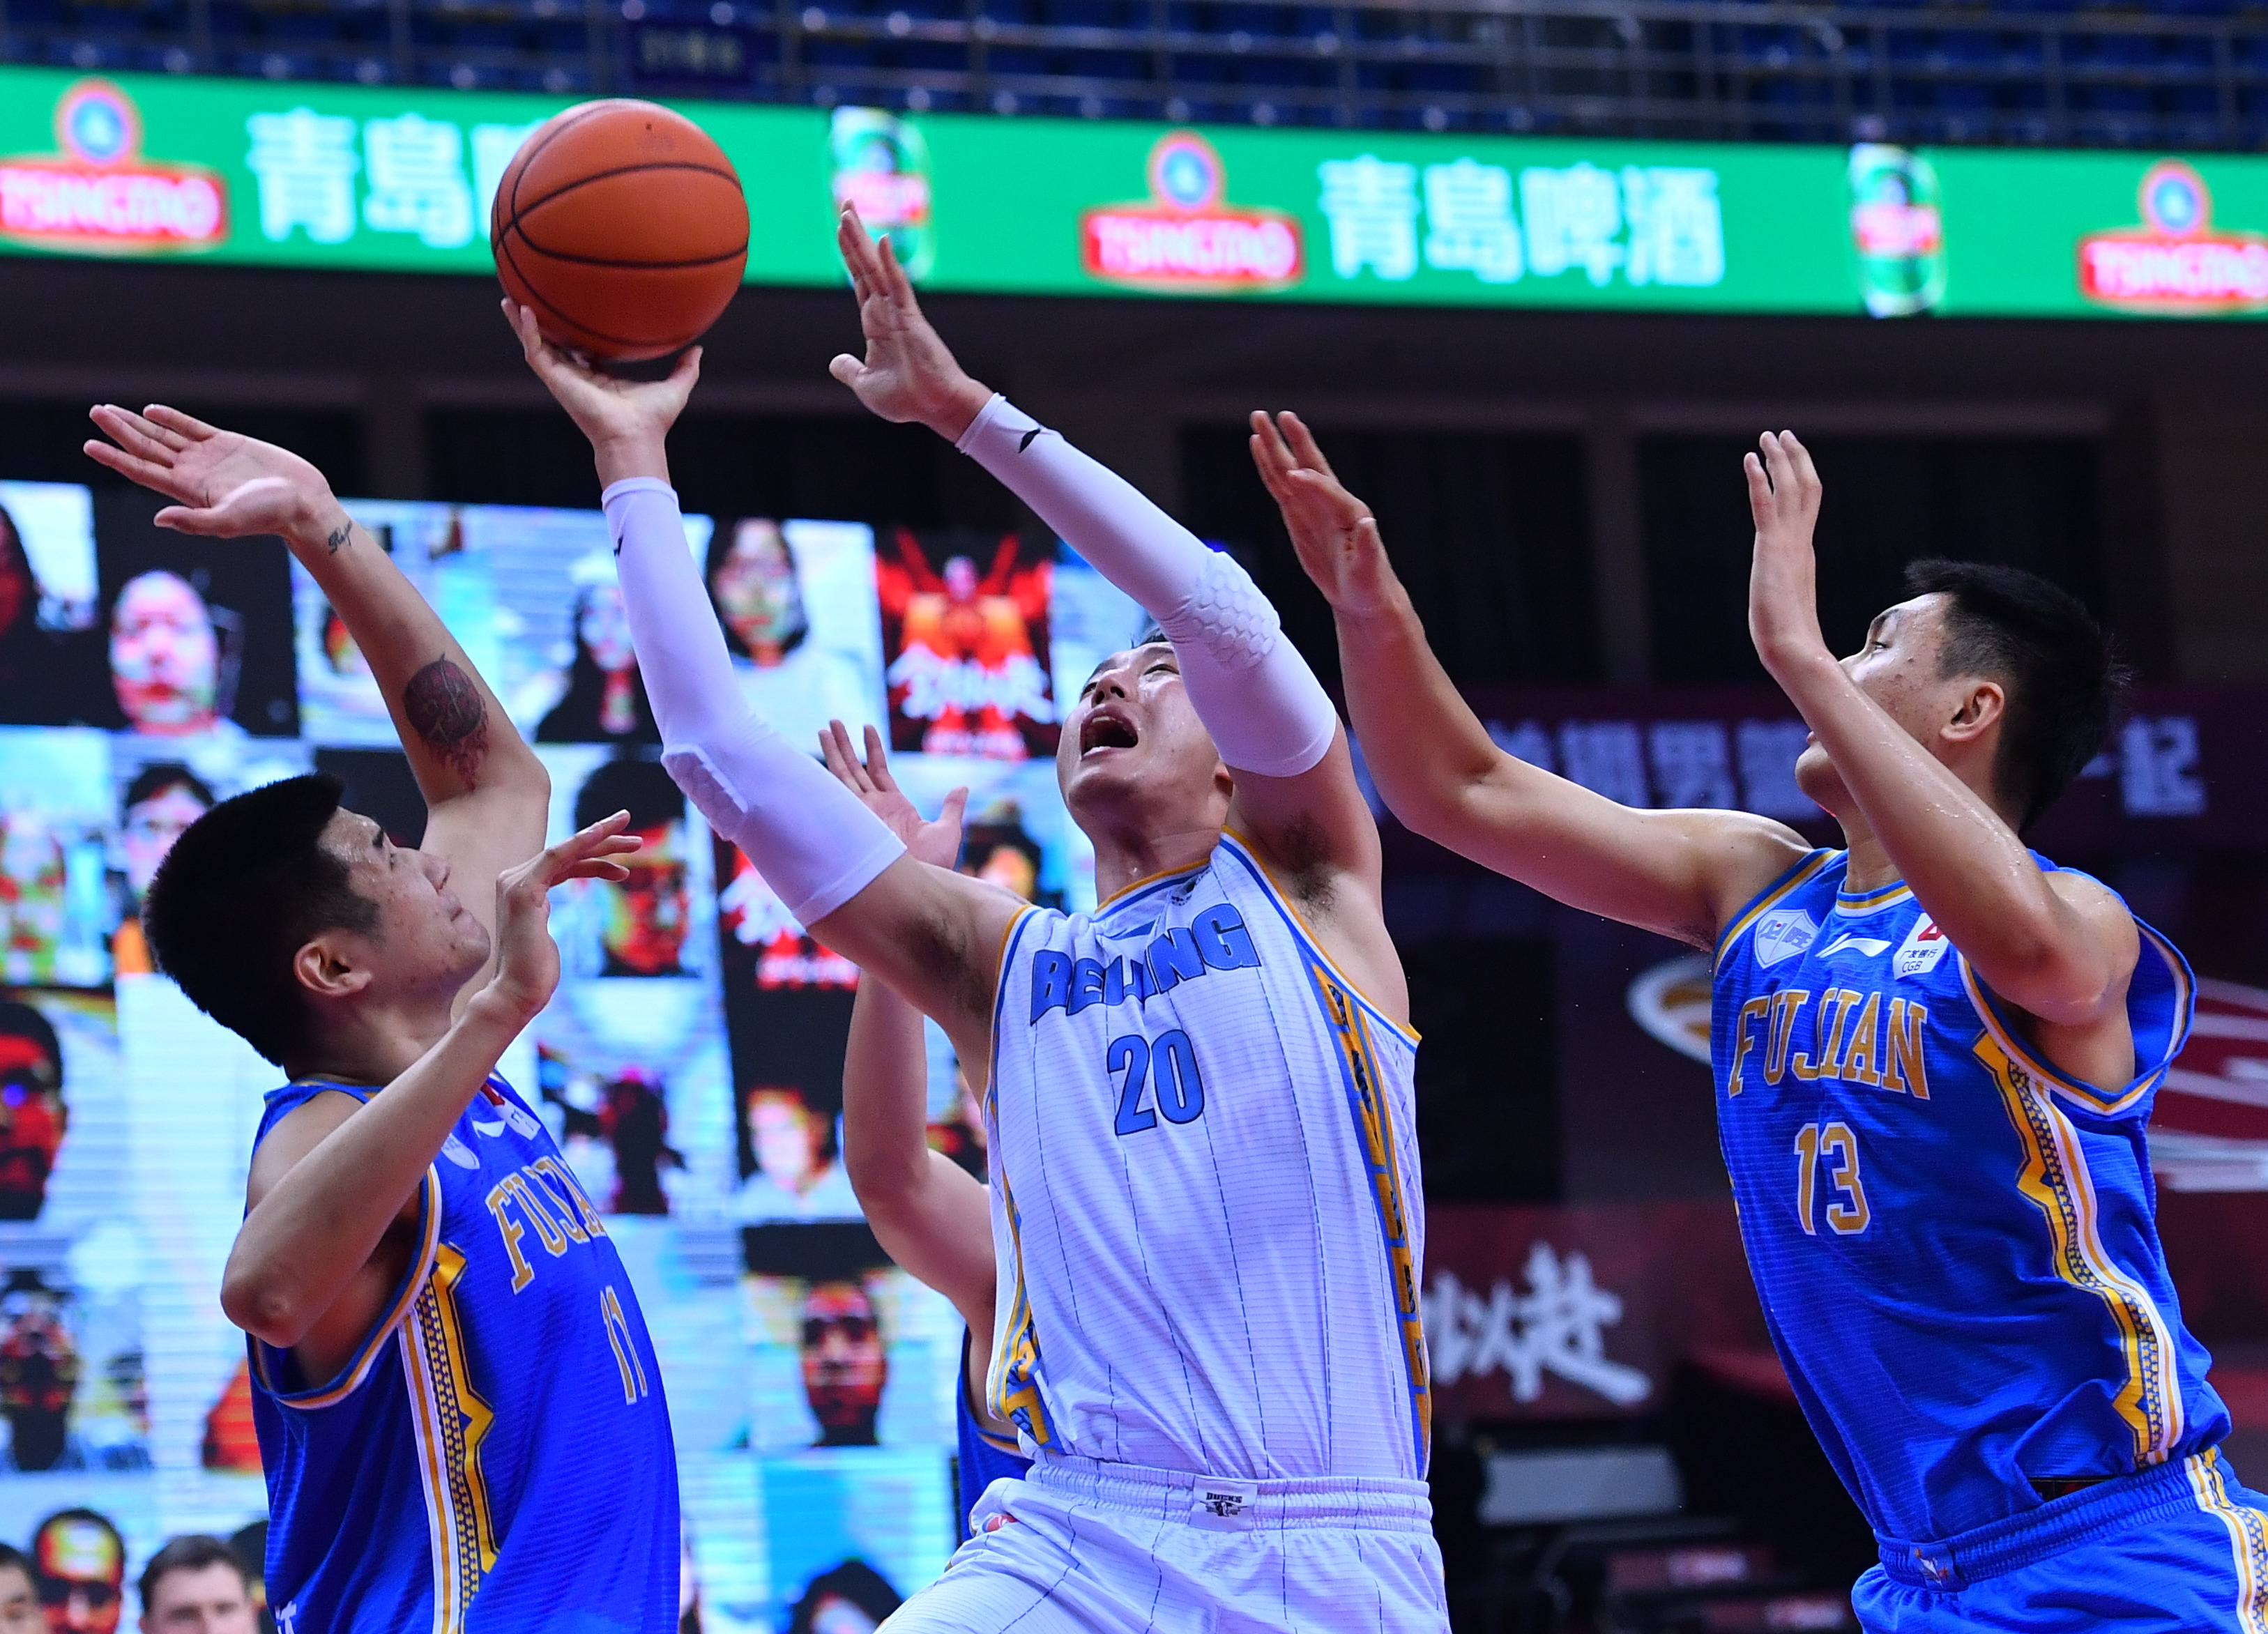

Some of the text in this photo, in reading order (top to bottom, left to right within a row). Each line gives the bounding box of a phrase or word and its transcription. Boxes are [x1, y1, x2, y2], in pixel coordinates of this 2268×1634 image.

[1090, 216, 1295, 279] TSINGTAO
[1317, 153, 1724, 287] 青岛啤酒
[1030, 903, 1261, 1026] BEIJING
[1902, 961, 1923, 974] CGB
[1107, 1029, 1204, 1136] 20
[1728, 987, 1931, 1100] FUJIAN
[1794, 1122, 1871, 1236] 13
[600, 1285, 648, 1405] 11
